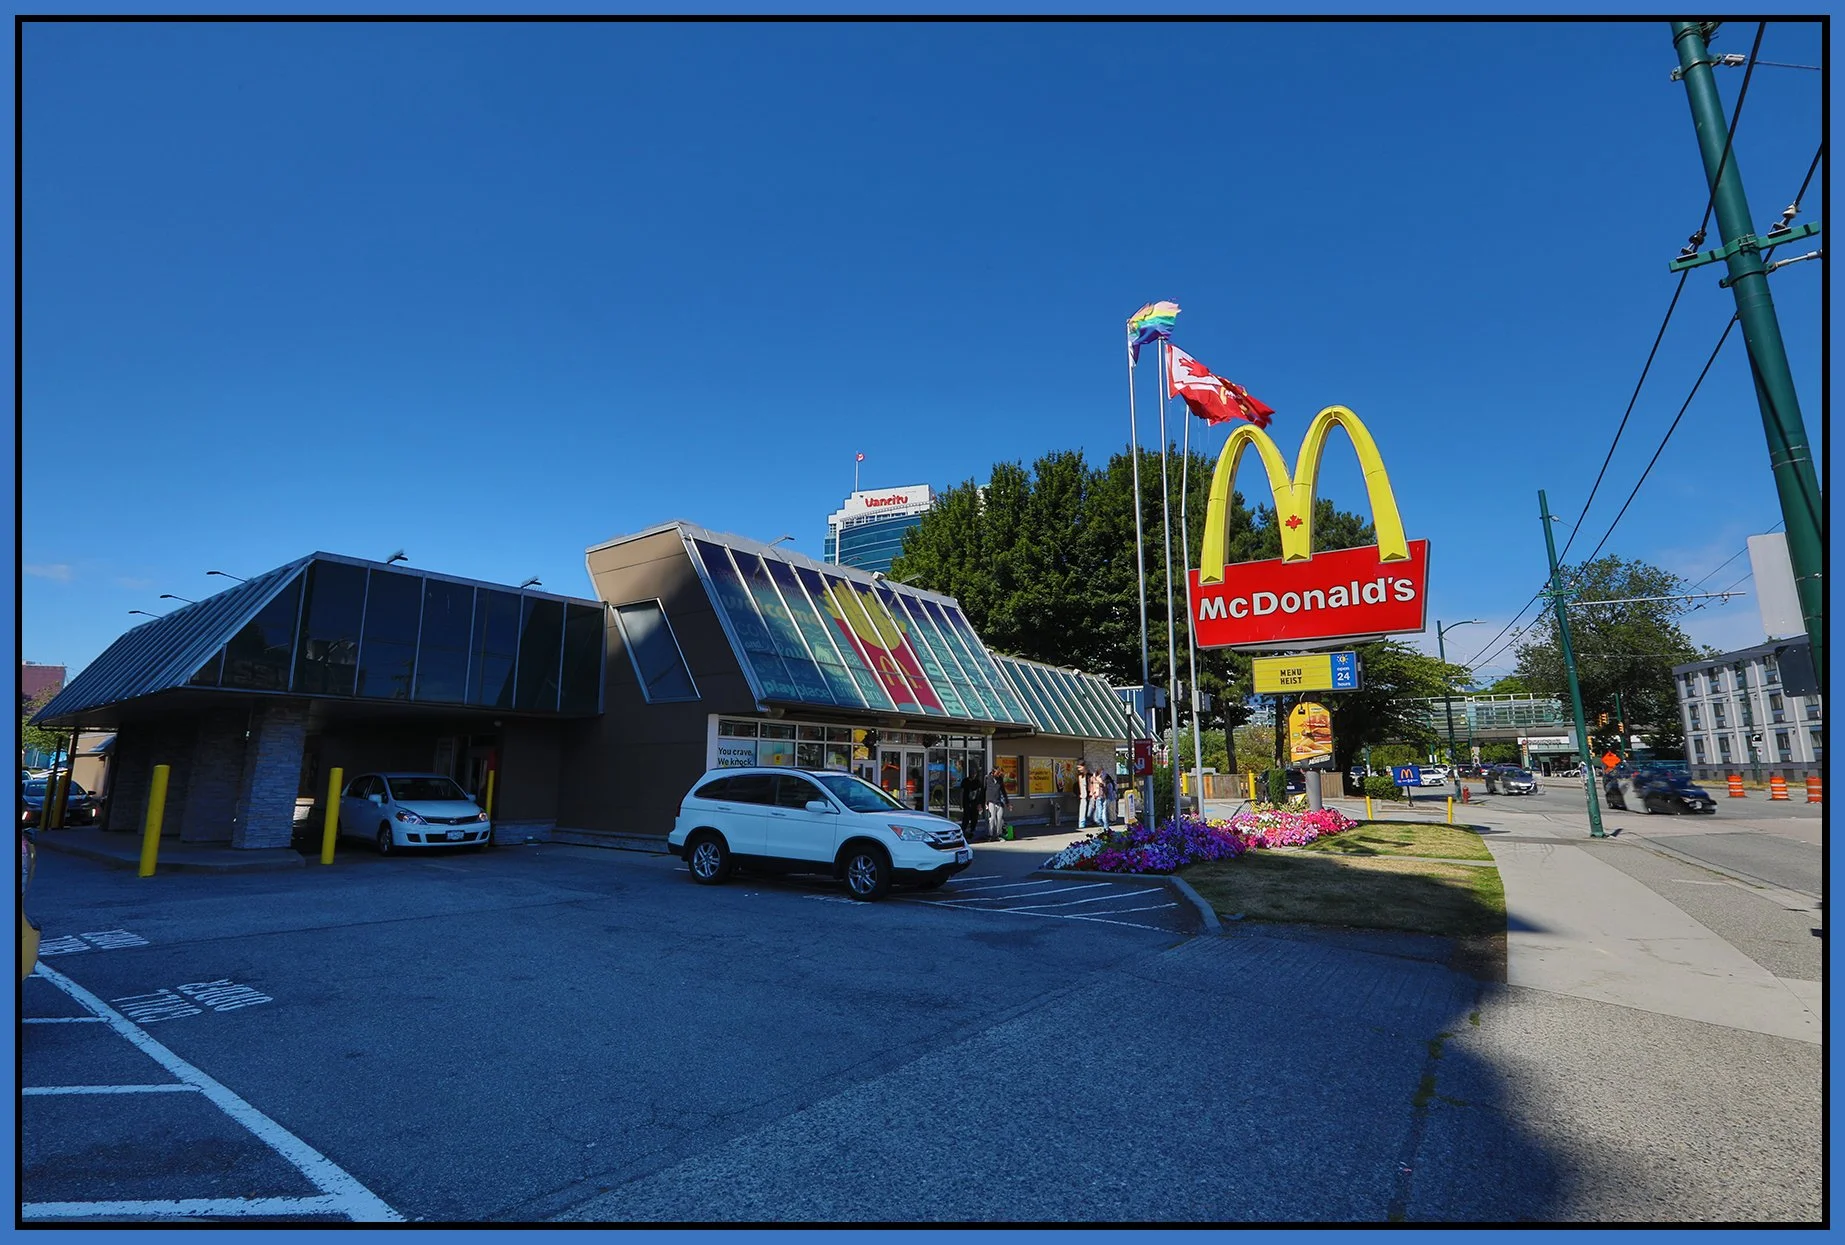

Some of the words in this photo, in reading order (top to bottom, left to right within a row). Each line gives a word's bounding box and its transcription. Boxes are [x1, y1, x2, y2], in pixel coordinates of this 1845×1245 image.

[865, 495, 908, 507] Vancity
[1198, 576, 1416, 621] McDonald's
[1280, 668, 1302, 677] MENU
[1337, 672, 1351, 681] 24
[1280, 677, 1302, 685] HEIST
[719, 747, 732, 755] You
